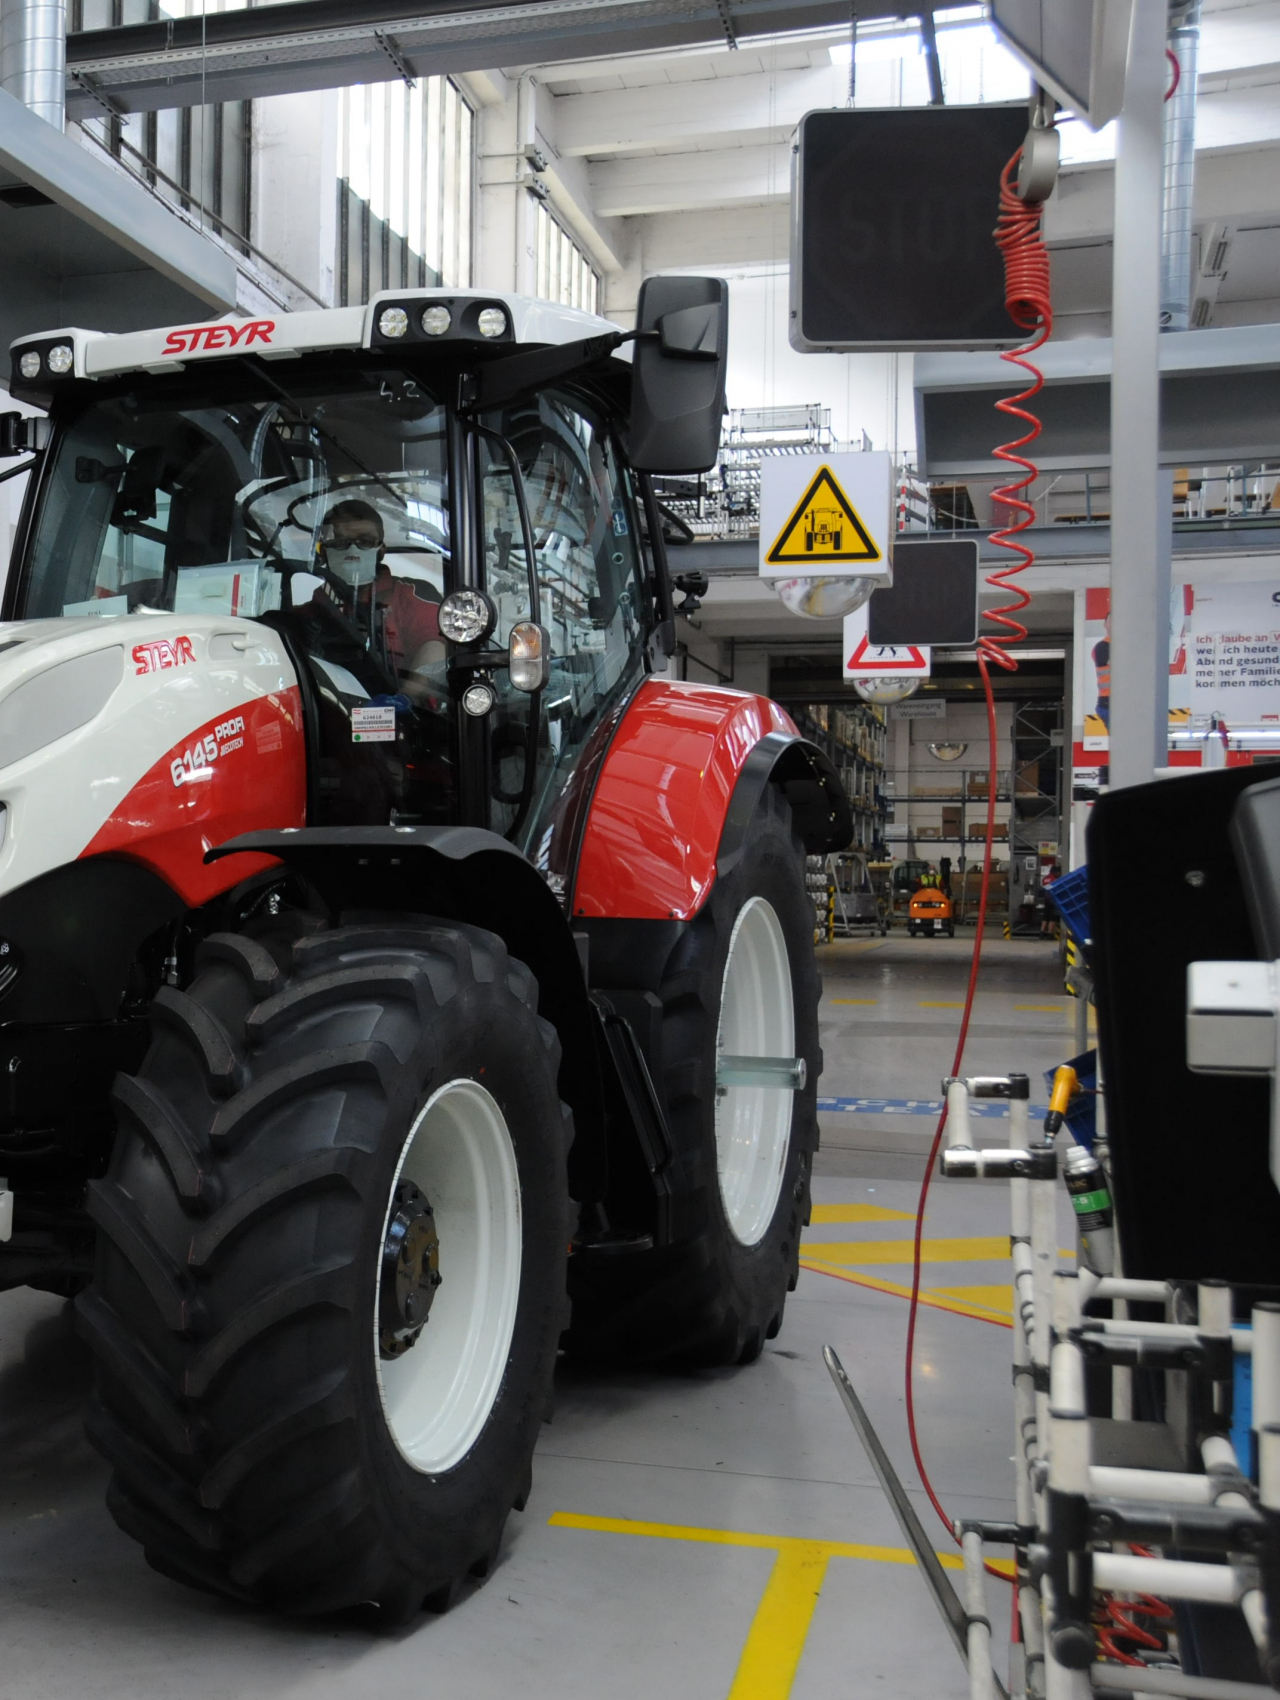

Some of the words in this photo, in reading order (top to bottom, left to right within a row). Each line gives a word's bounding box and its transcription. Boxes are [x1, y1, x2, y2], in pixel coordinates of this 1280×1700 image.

[161, 321, 276, 355] STEYR
[1196, 635, 1212, 644] Ich
[1220, 634, 1252, 644] laube
[1254, 633, 1269, 642] an
[132, 635, 196, 675] STEYR
[1223, 645, 1240, 654] ich
[1244, 645, 1278, 654] heute
[1236, 656, 1279, 667] gesund
[1195, 669, 1237, 677] mener
[215, 715, 245, 742] PROFI
[170, 733, 219, 788] 6145
